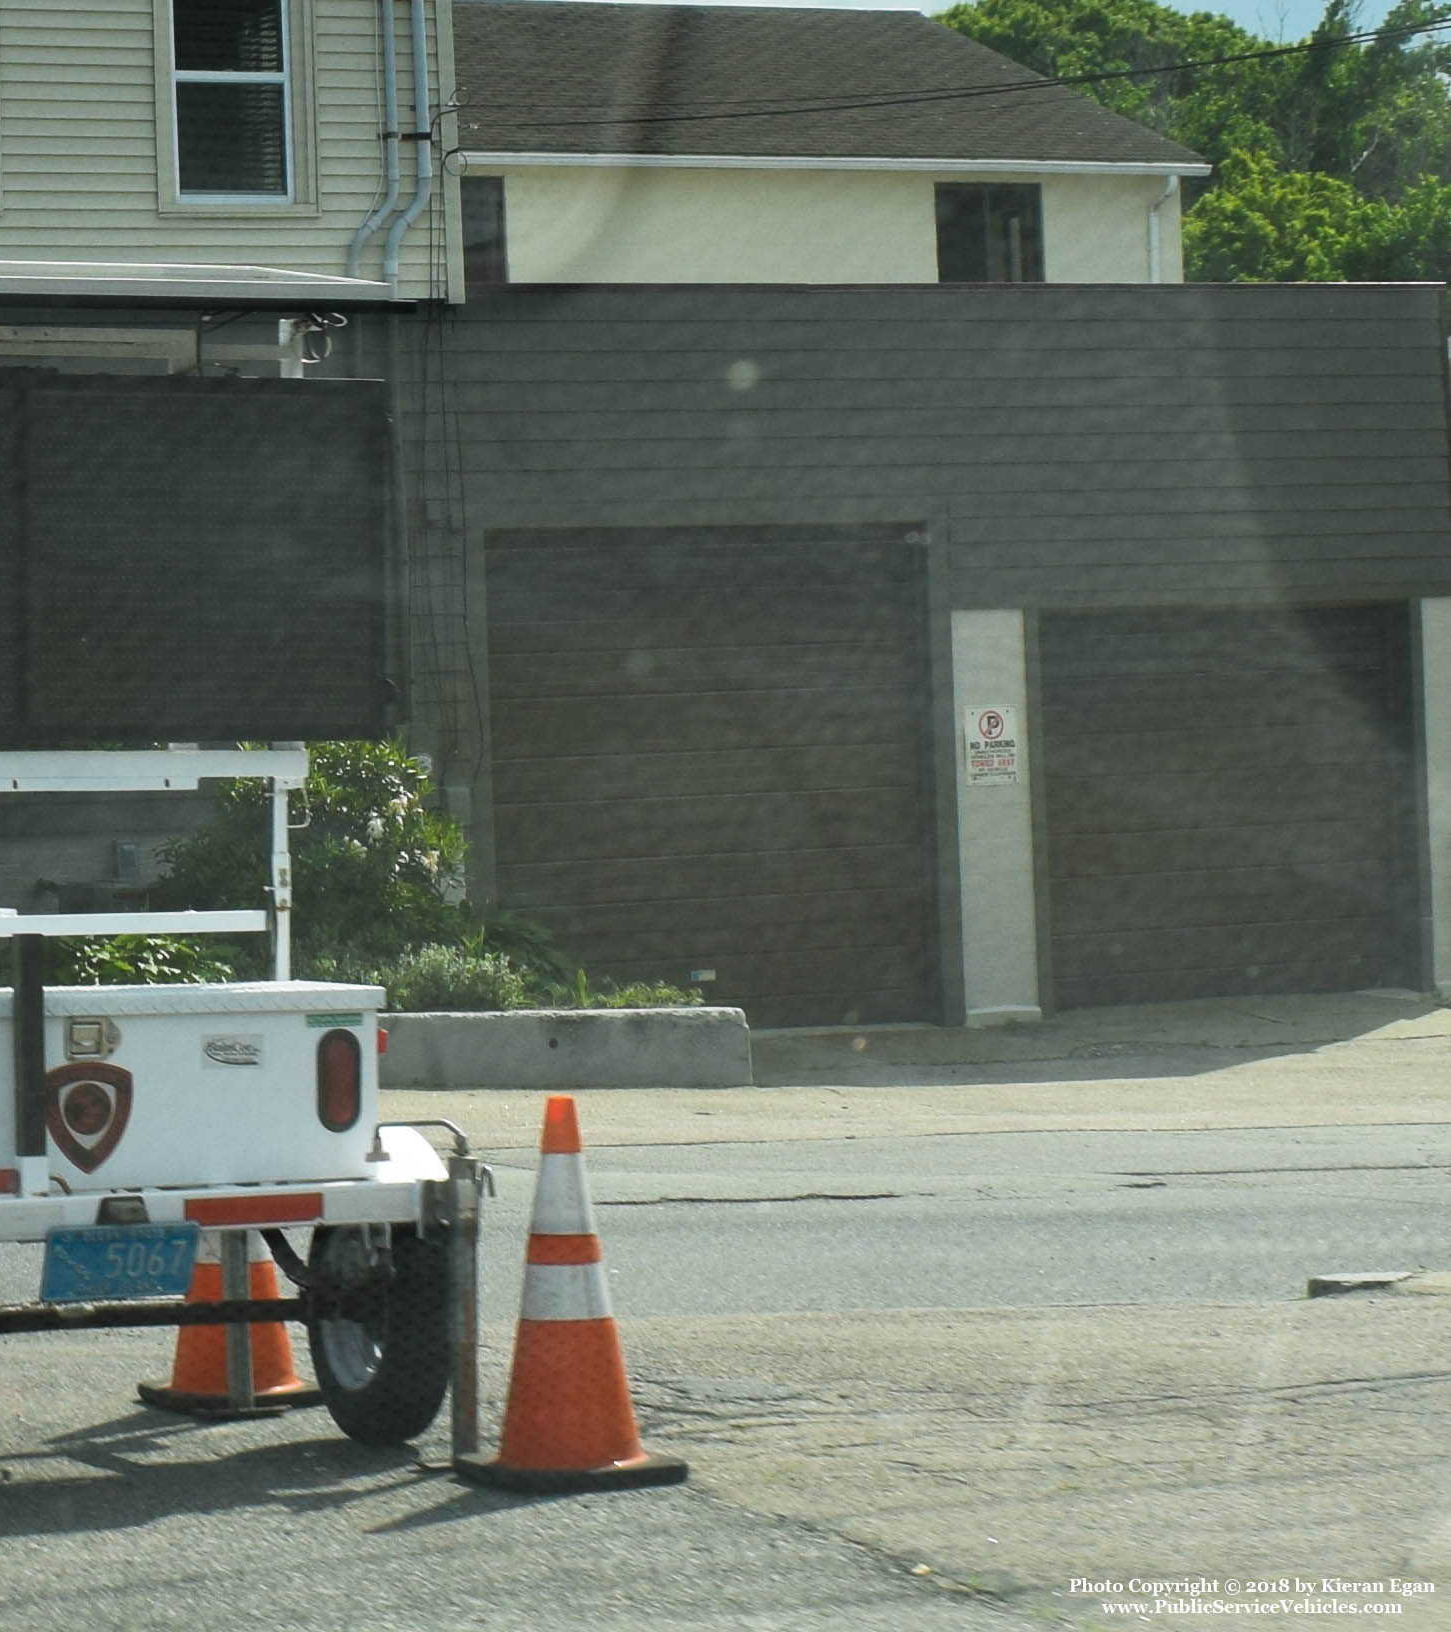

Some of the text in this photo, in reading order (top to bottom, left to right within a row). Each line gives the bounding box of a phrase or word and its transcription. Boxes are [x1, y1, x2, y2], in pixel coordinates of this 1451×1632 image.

[970, 740, 1016, 750] NO PARKING
[105, 1239, 188, 1280] 5067
